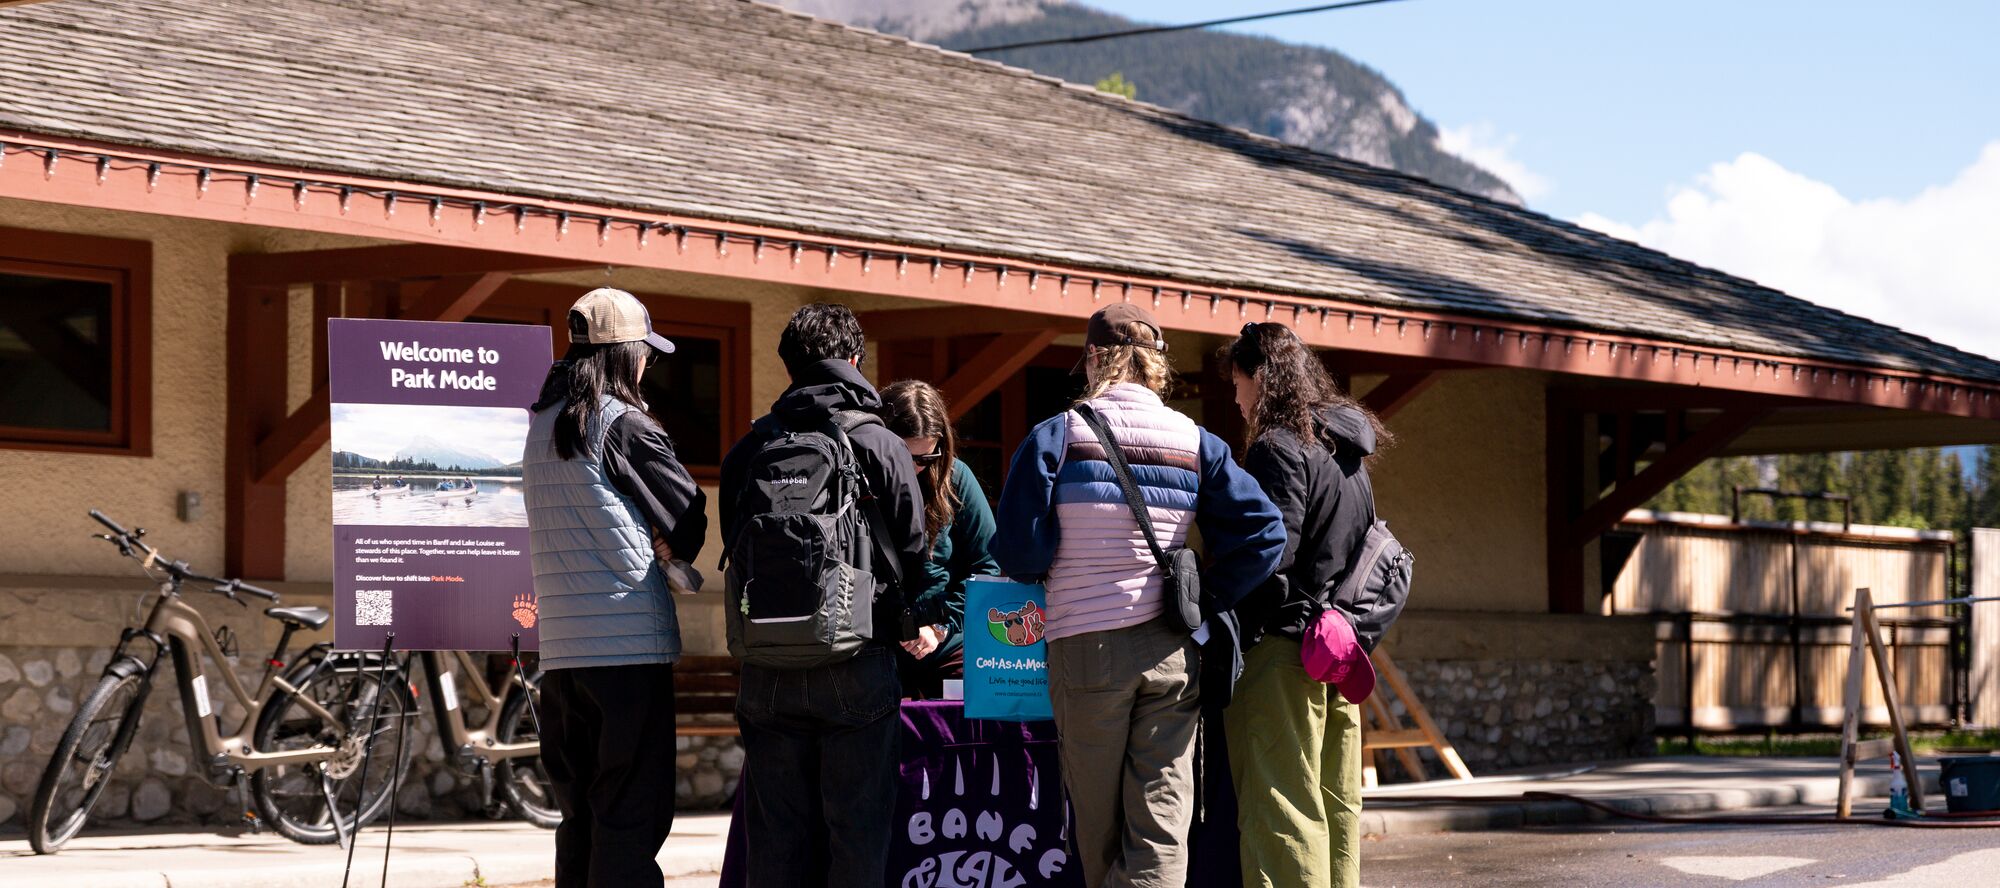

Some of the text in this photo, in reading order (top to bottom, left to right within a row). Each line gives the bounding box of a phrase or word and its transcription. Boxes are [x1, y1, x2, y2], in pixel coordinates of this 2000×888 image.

[380, 341, 499, 364] Welcome to
[391, 368, 496, 391] Park Mode
[389, 547, 401, 555] this
[401, 548, 419, 556] place.
[418, 548, 446, 556] Together,
[467, 548, 480, 557] help
[481, 548, 497, 556] leave
[393, 538, 411, 547] spend
[355, 574, 382, 582] Discover
[382, 574, 396, 582] how
[908, 808, 1066, 879] BANFF
[934, 850, 1027, 888] LAK
